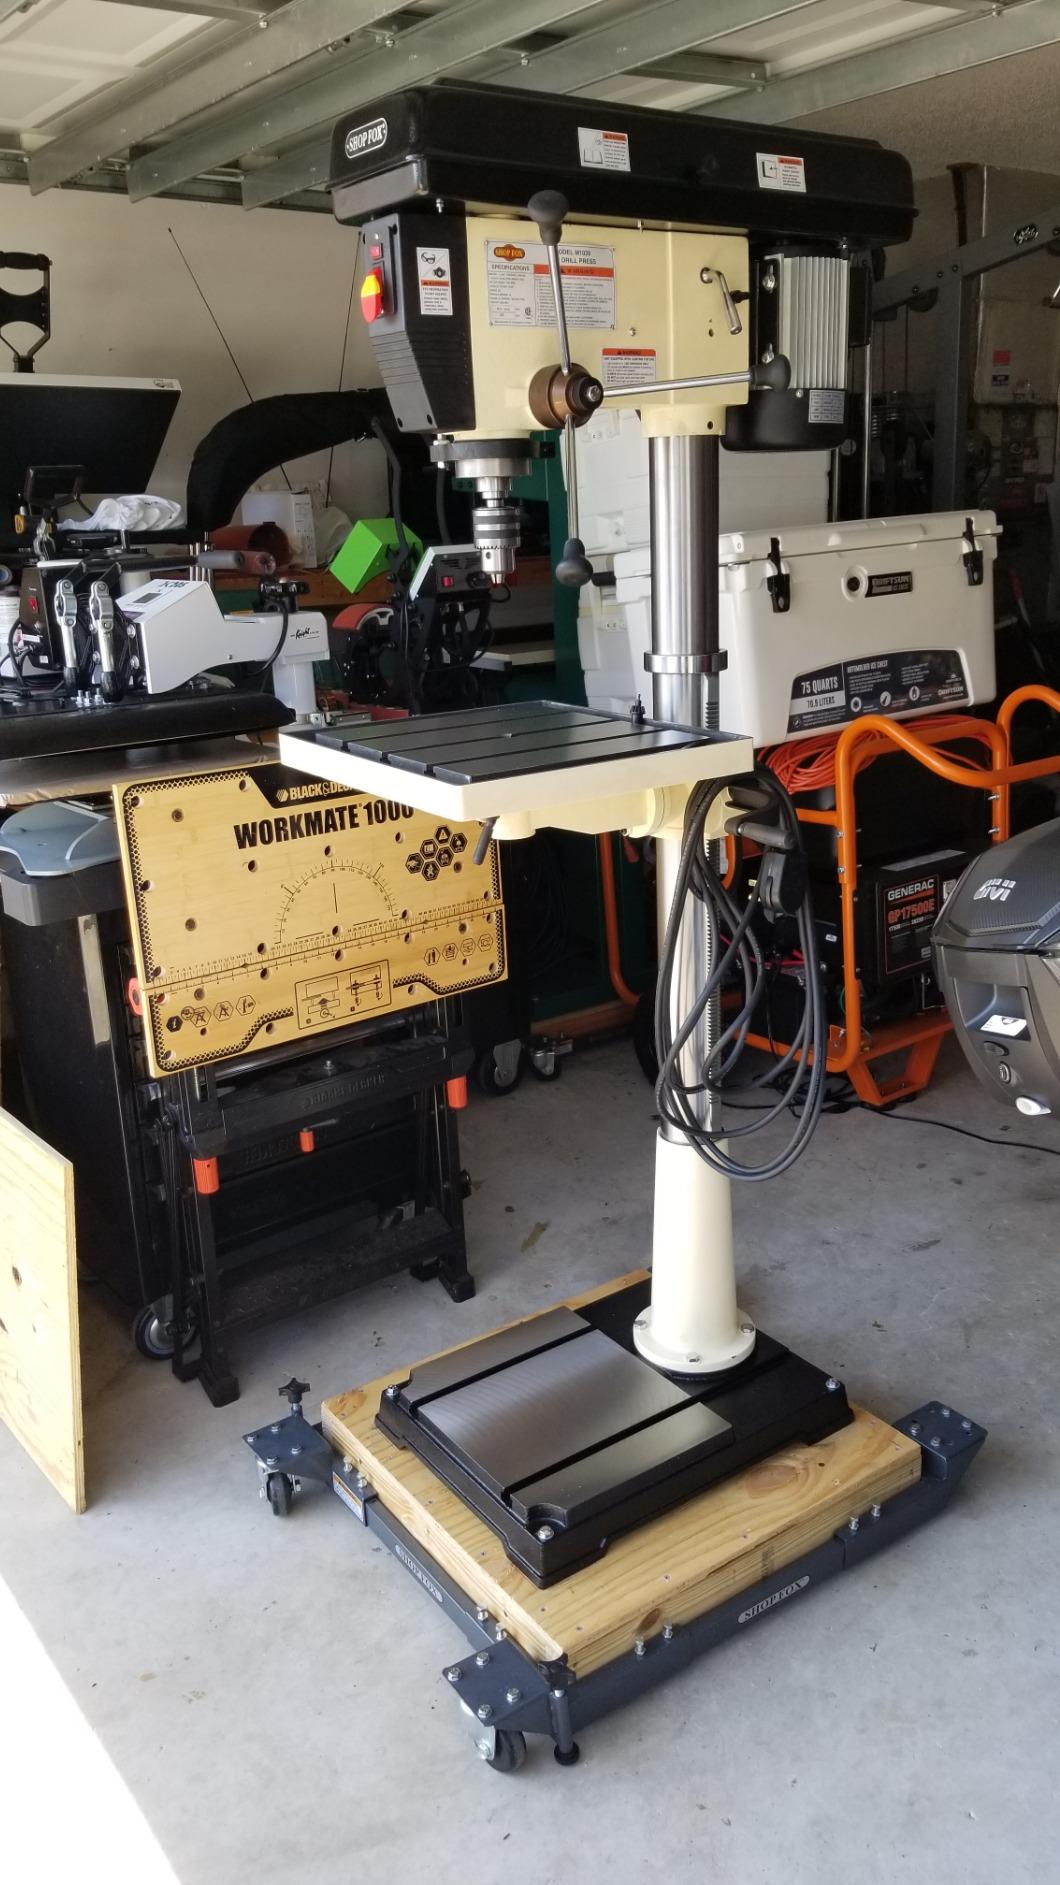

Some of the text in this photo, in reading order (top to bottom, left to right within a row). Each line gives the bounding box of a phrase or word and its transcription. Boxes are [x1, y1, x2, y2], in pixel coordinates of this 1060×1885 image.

[349, 125, 383, 152] SHOP FOX
[496, 247, 523, 258] SHOP FOX
[559, 248, 574, 256] ODEL
[801, 681, 811, 695] 75
[812, 676, 838, 694] QUARTS
[289, 782, 353, 801] BLACK&DEC
[233, 799, 415, 850] WORKMATE 1000
[887, 879, 935, 901] GENERAC
[887, 899, 935, 924] GP17500E
[745, 1582, 801, 1620] SHOP FOX
